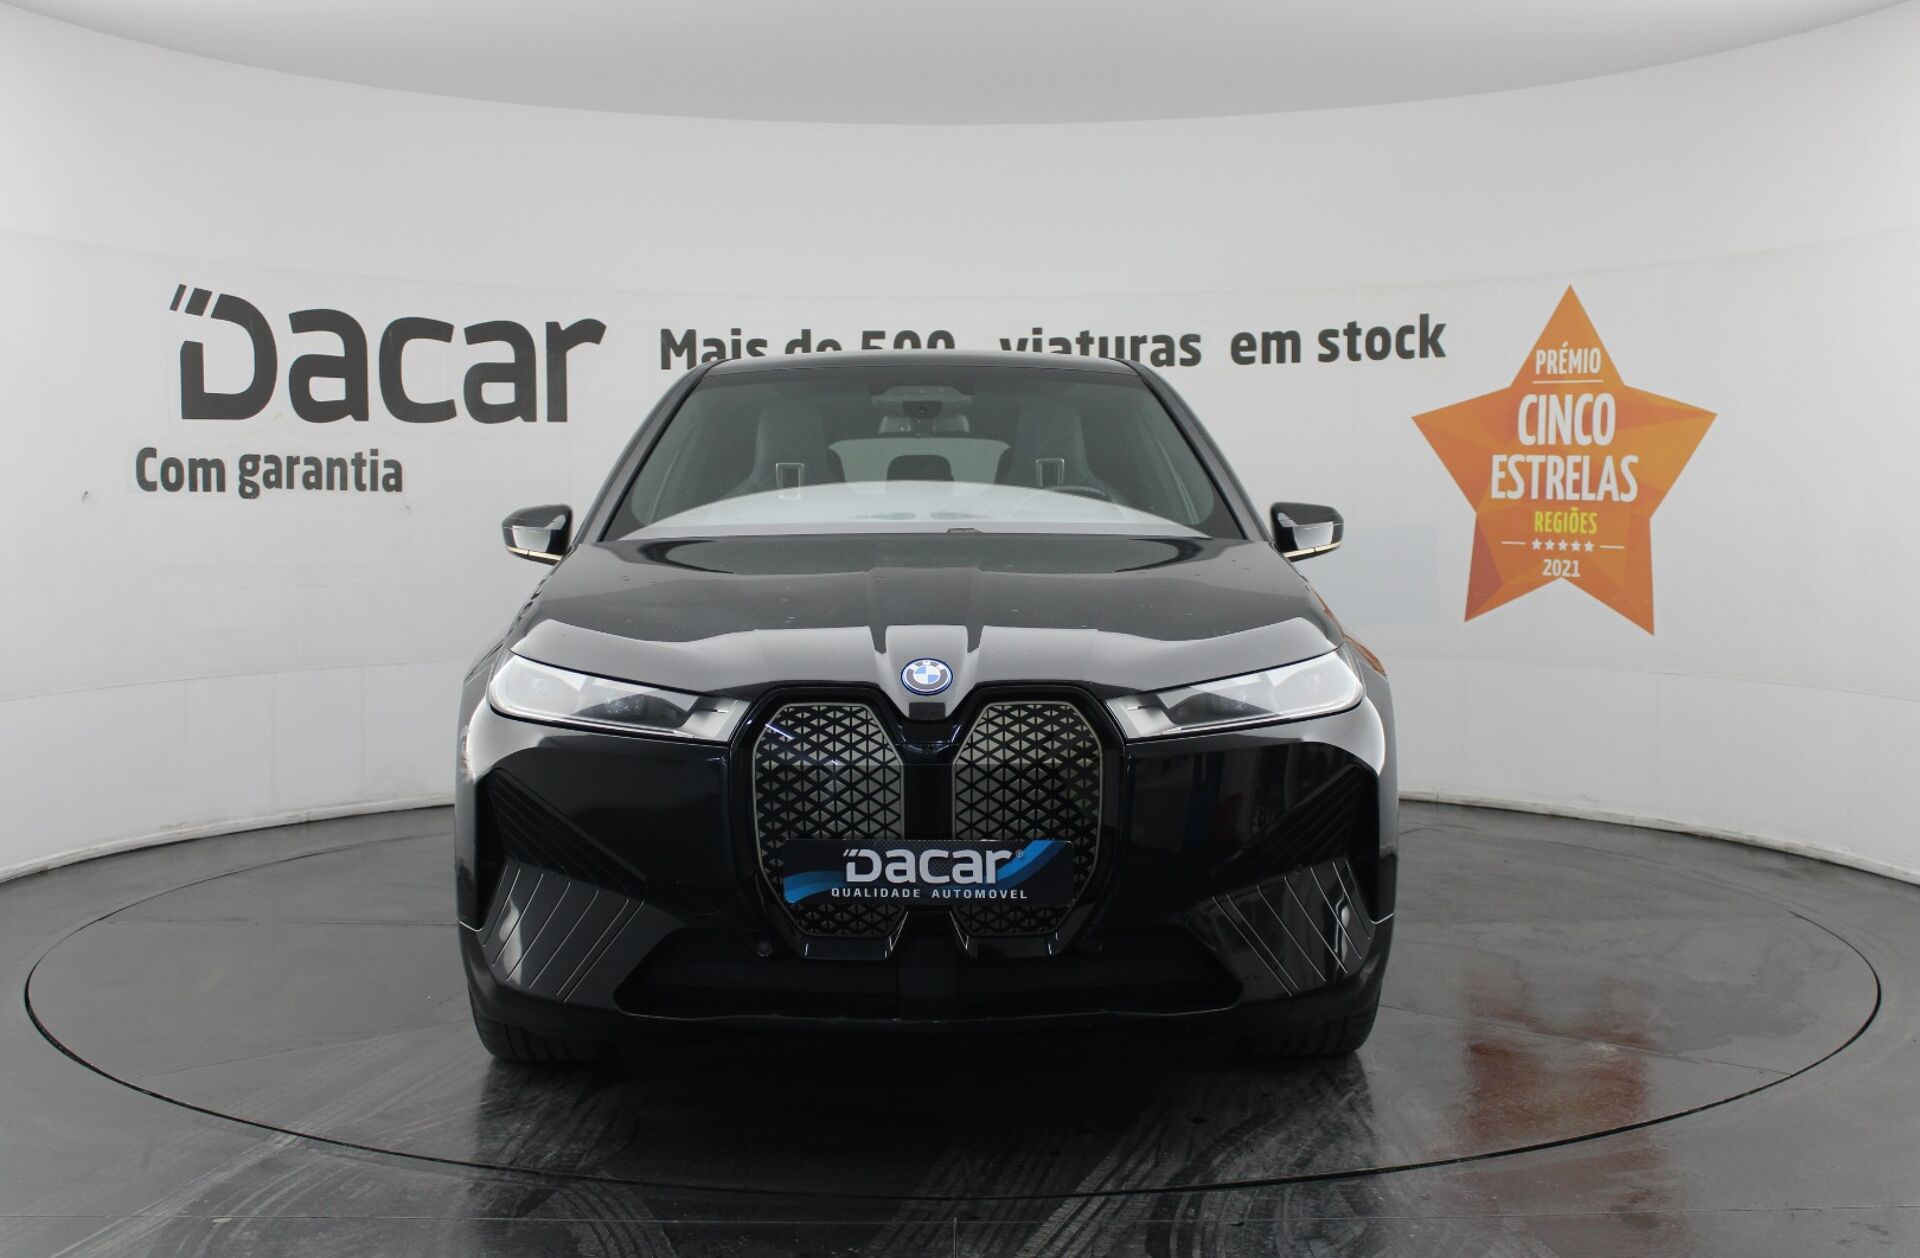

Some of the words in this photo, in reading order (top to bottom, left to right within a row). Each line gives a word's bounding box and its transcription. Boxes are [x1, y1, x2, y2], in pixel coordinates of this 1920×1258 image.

[169, 284, 607, 424] Dacar
[660, 327, 768, 370] Mais
[1230, 331, 1301, 366] em
[1317, 314, 1447, 363] stock
[1535, 342, 1601, 375] PRÉMIO
[1517, 393, 1616, 446] CINCO
[135, 446, 226, 493] Com
[238, 448, 403, 500] garantia
[1490, 454, 1639, 502] ESTRELAS
[1534, 507, 1598, 534] REGIÕES
[1542, 558, 1581, 577] 2021
[843, 848, 1013, 884] Dacar
[831, 887, 921, 898] QUALIDADE
